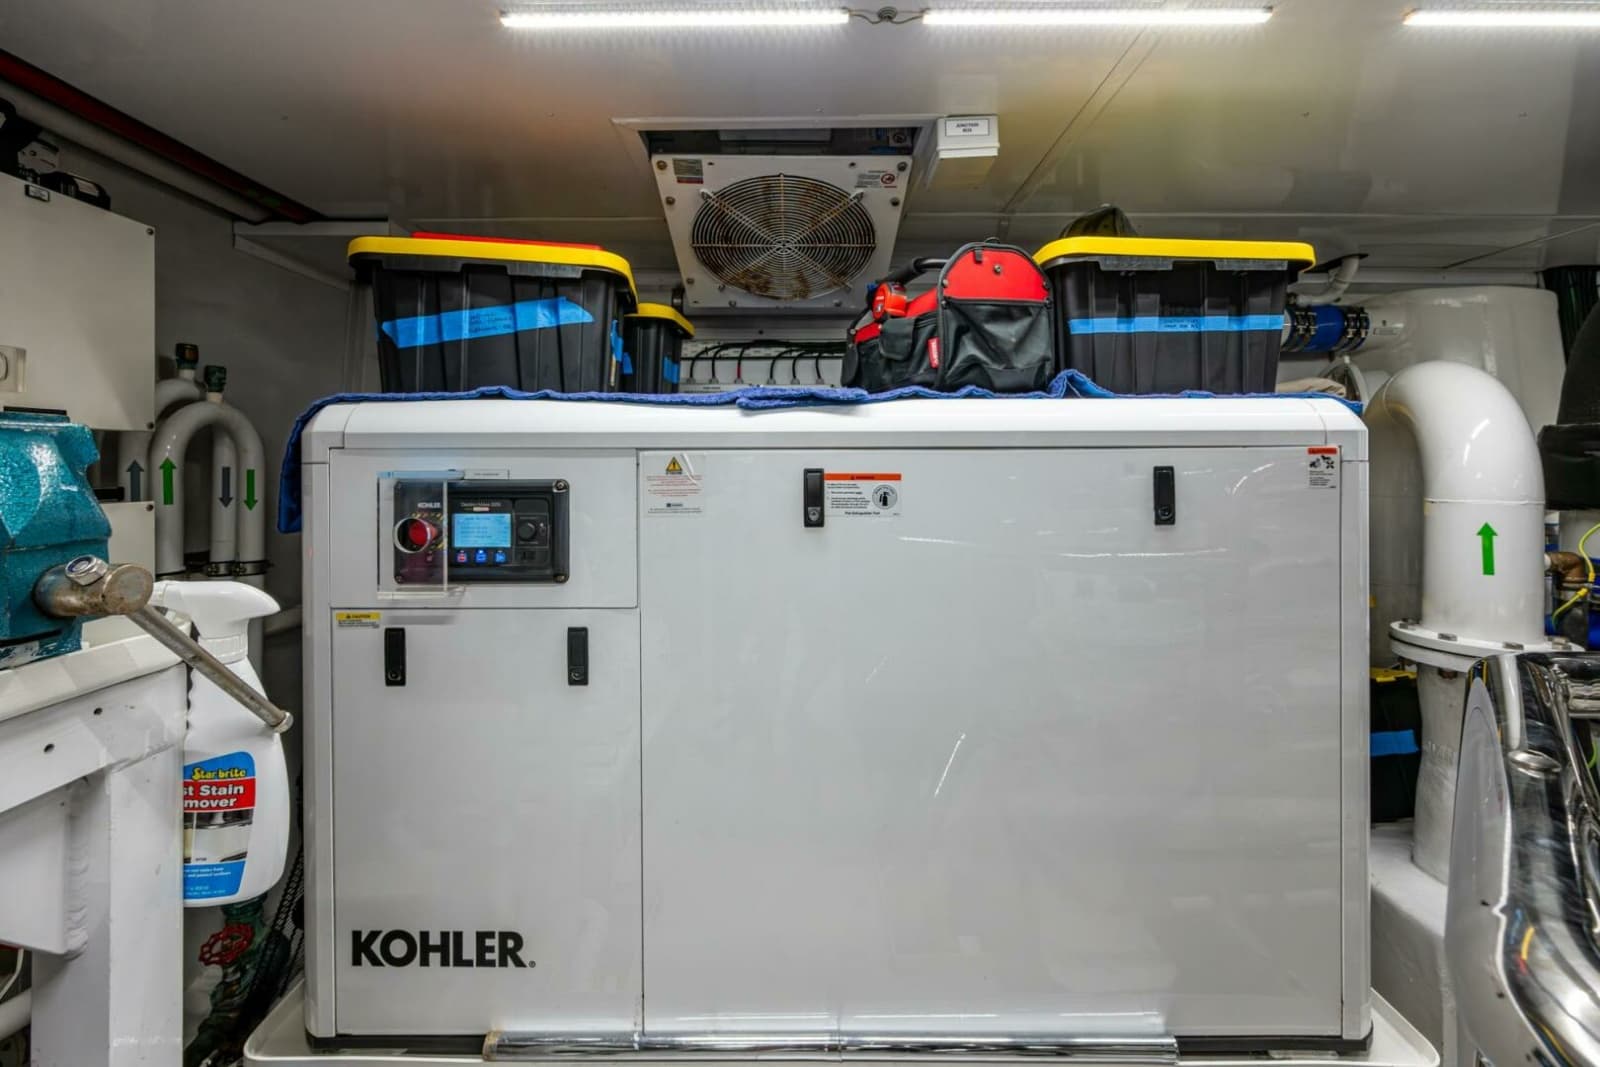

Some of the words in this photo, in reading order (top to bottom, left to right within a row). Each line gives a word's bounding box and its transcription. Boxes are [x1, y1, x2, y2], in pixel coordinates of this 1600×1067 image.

[200, 784, 244, 796] Stain
[184, 798, 237, 808] mover
[351, 929, 528, 968] KOHLER
